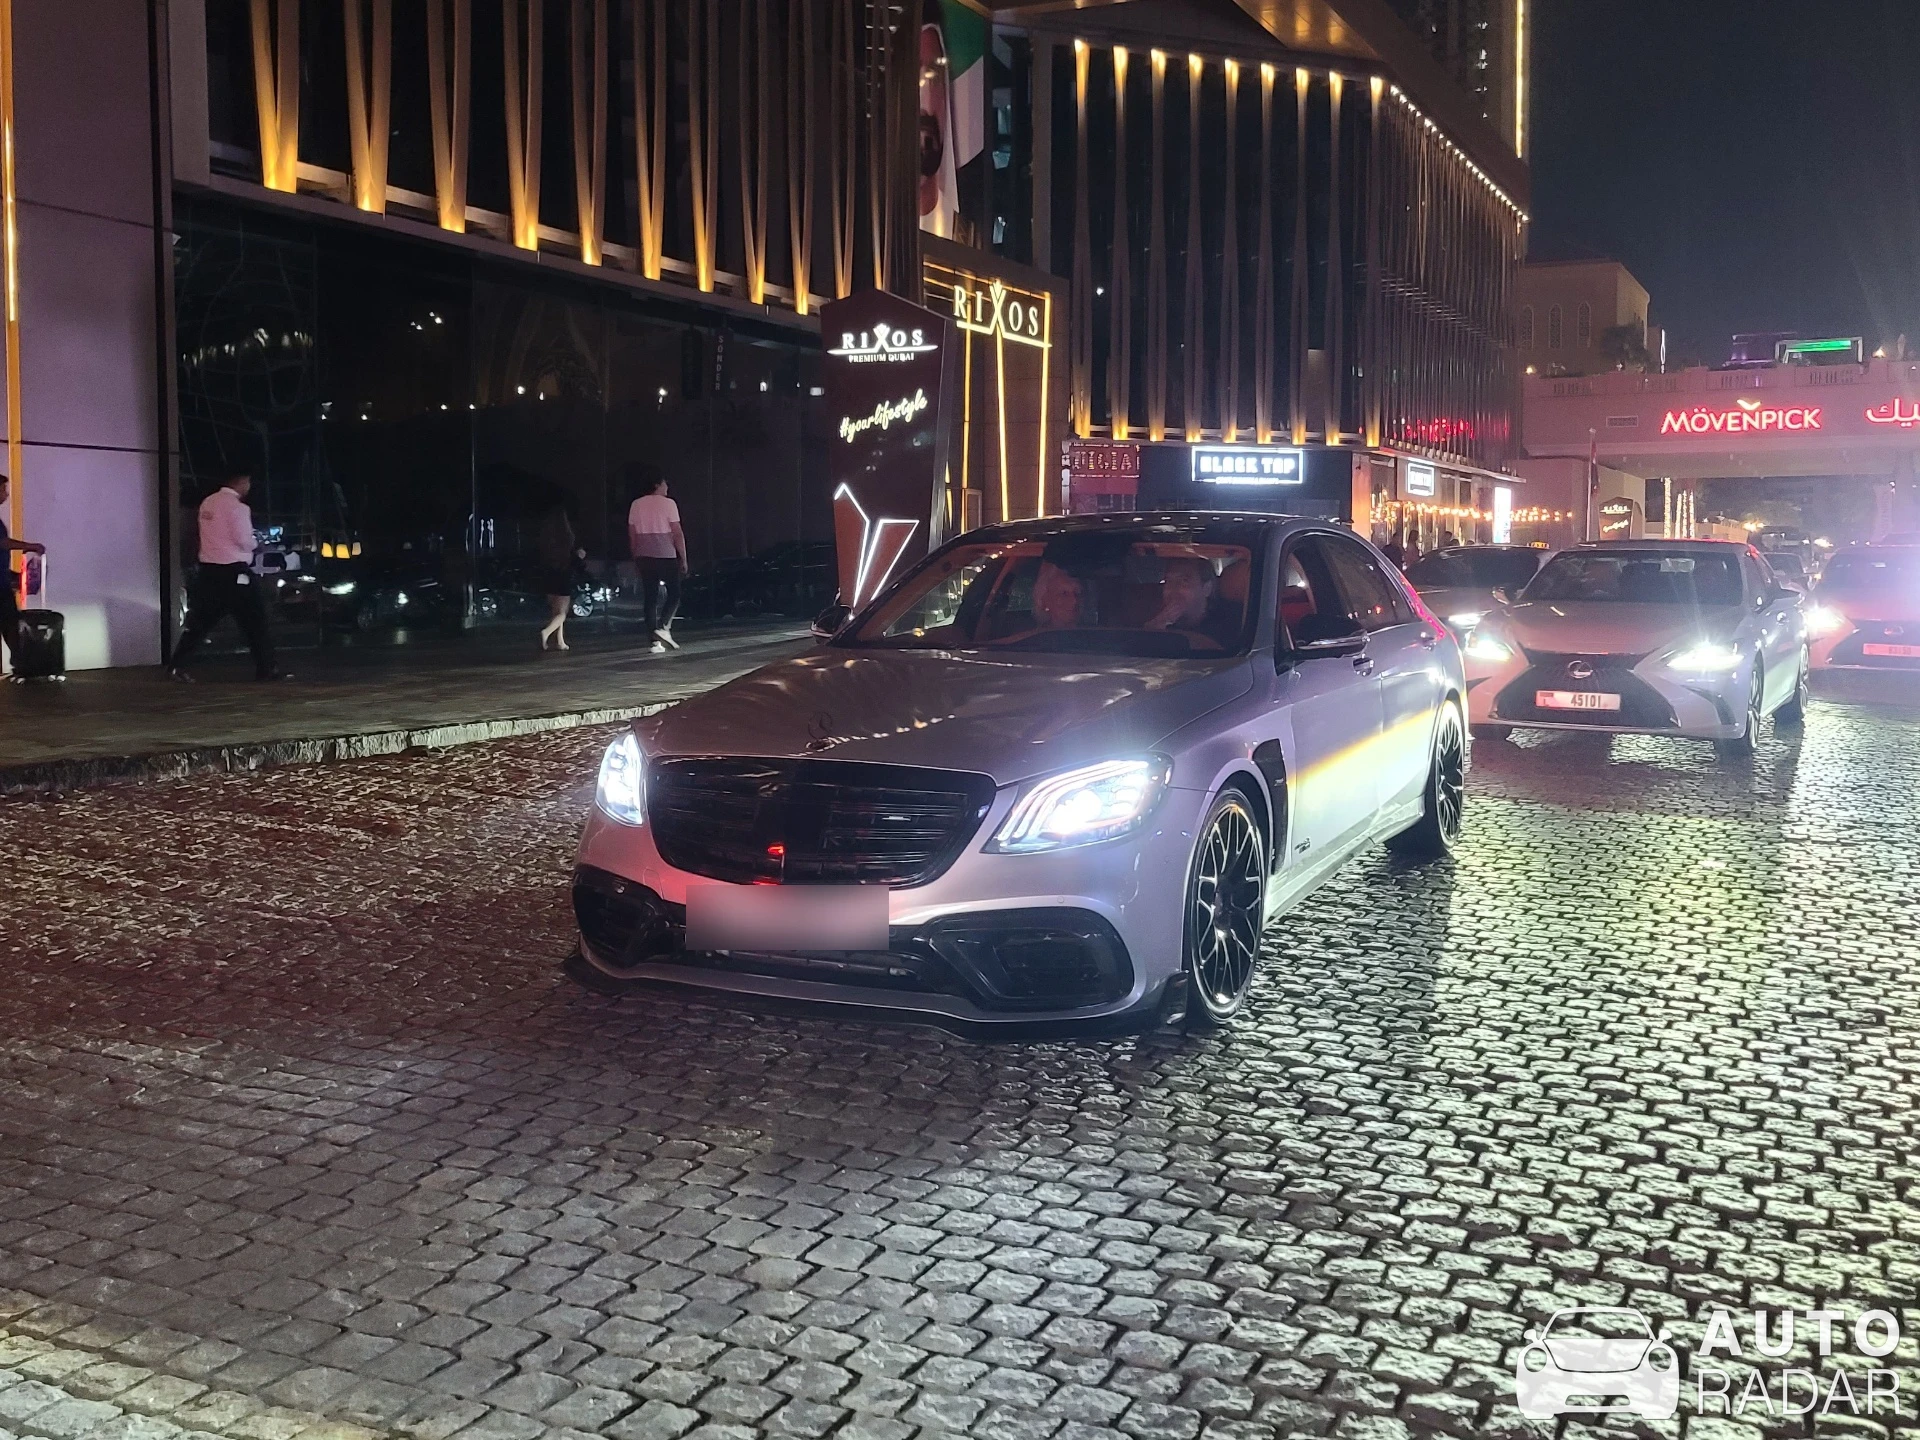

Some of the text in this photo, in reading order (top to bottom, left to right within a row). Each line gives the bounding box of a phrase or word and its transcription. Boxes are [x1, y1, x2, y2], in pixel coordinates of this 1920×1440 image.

[953, 279, 1039, 336] RIXOS
[841, 323, 924, 350] RIXOS
[715, 335, 724, 391] SONDER
[848, 352, 915, 363] PREMIUM DUBAI
[839, 387, 928, 443] #yourlifestyle
[1660, 407, 1821, 434] MÖVENPICK
[1200, 456, 1295, 474] BLACK TAP
[1570, 694, 1602, 708] 45101
